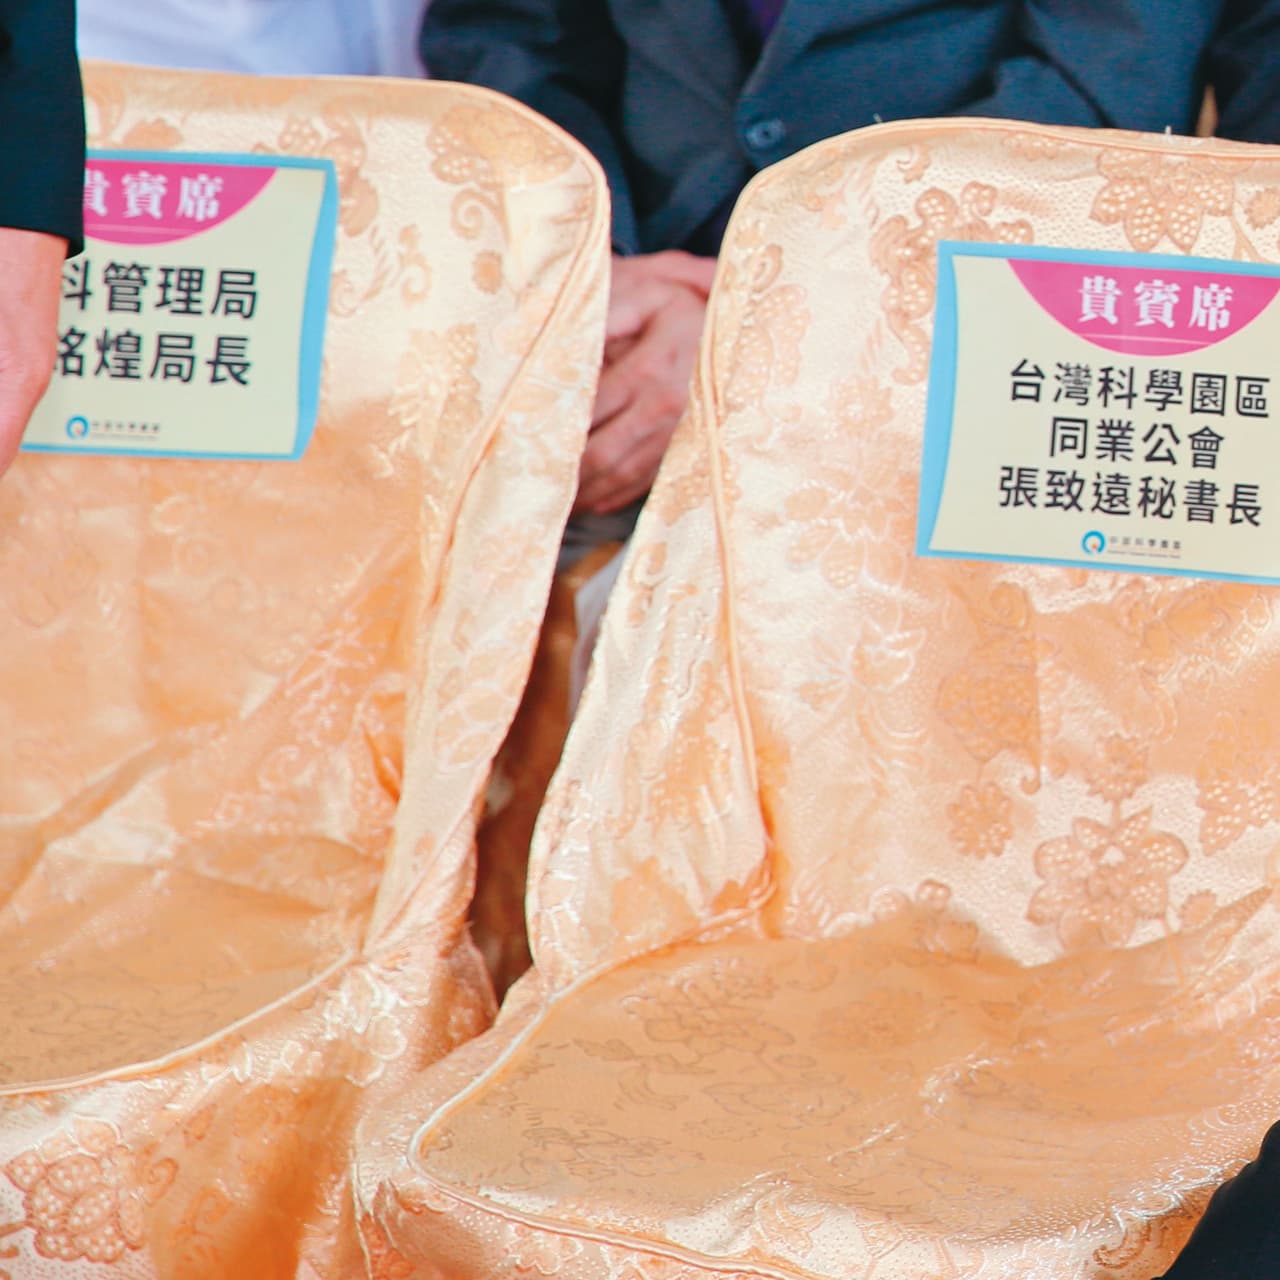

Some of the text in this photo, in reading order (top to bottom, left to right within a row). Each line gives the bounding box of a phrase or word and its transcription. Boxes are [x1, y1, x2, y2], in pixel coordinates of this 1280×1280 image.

[1077, 275, 1235, 331] 貴賓席
[1010, 358, 1271, 418] 台灣科學園區
[1050, 416, 1225, 470] 同業公會
[998, 466, 1263, 527] 張致遠秘書長
